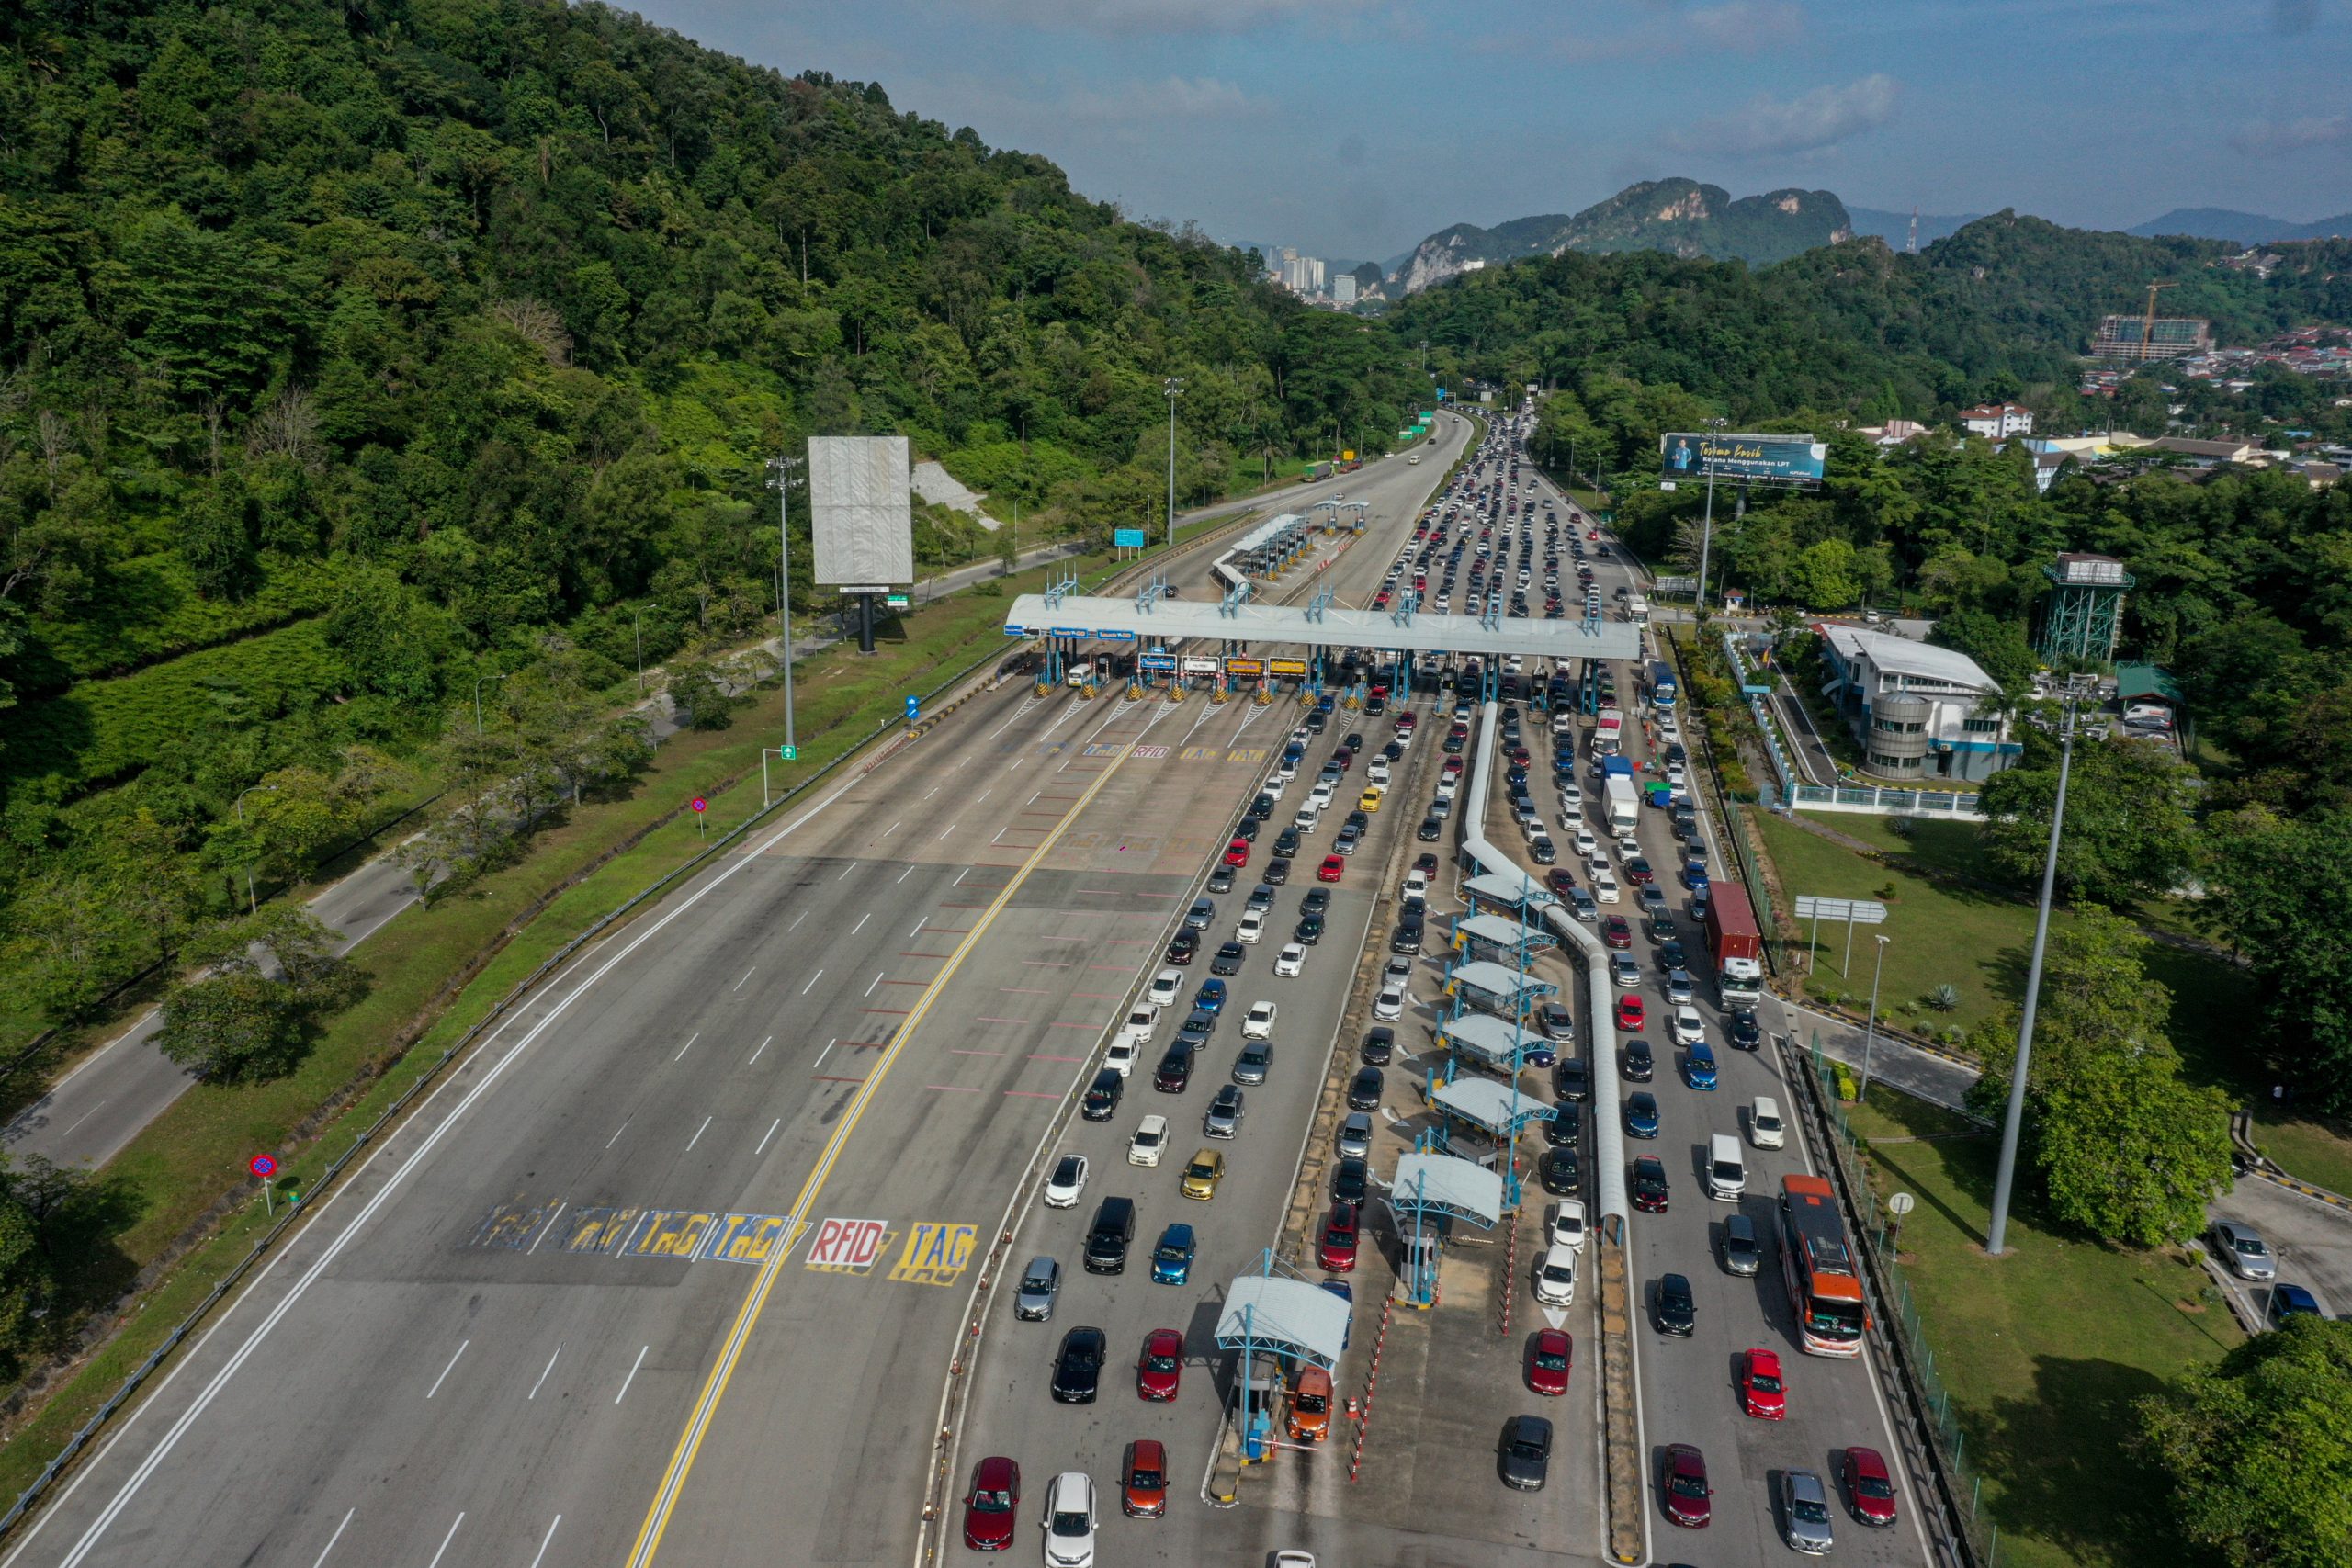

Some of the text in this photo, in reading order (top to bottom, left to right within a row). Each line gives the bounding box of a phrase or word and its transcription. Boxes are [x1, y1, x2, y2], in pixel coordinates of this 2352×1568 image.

[1727, 457, 1776, 467] Menggunakan
[1133, 746, 1169, 758] RFID
[809, 1220, 883, 1263] RFID
[910, 1224, 973, 1268] TAG
